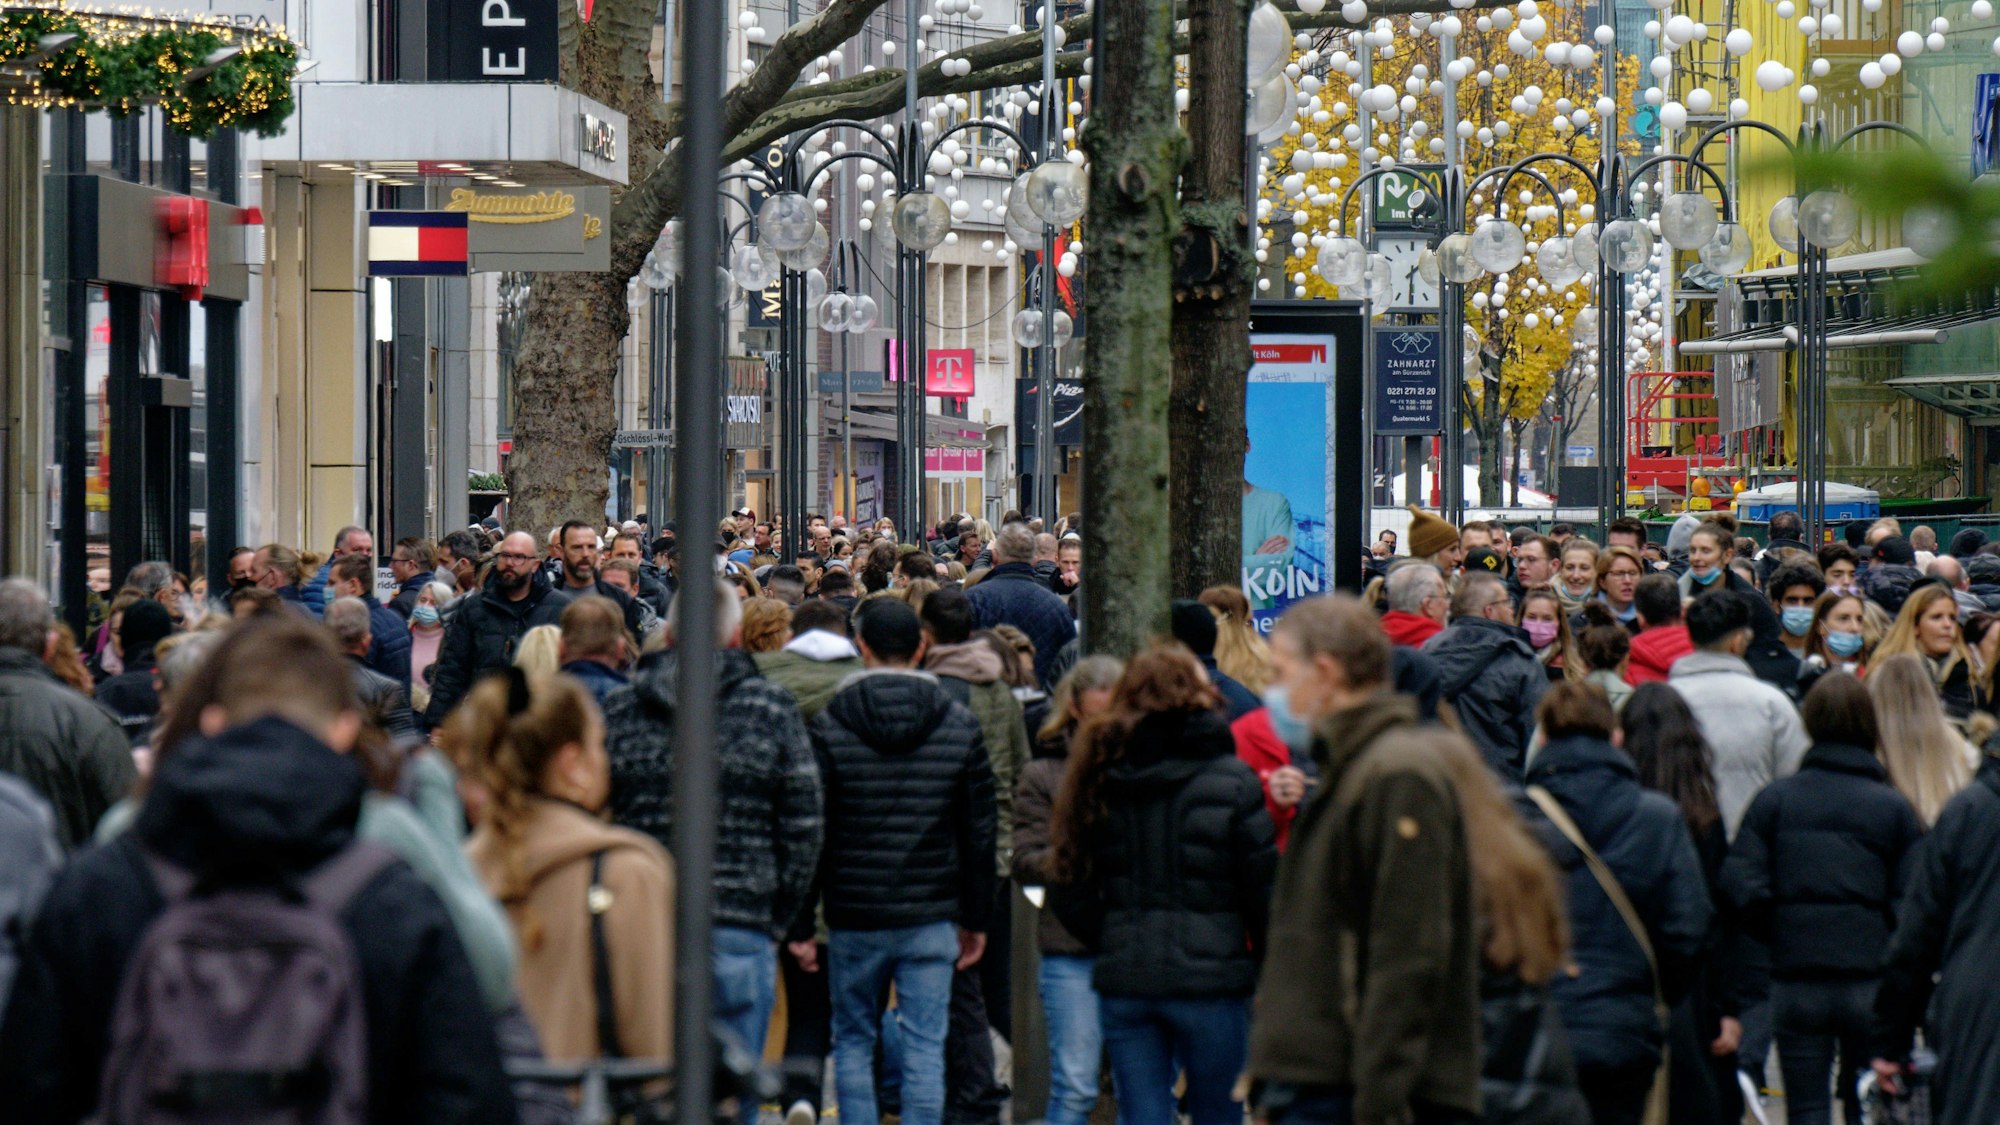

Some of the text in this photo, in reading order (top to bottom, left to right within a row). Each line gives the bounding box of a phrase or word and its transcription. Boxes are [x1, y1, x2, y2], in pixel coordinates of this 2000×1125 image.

[1391, 208, 1406, 219] Im
[1260, 349, 1280, 359] Köln
[1387, 360, 1436, 368] ZAHNARZT
[1387, 387, 1436, 395] 0221 271 21 20
